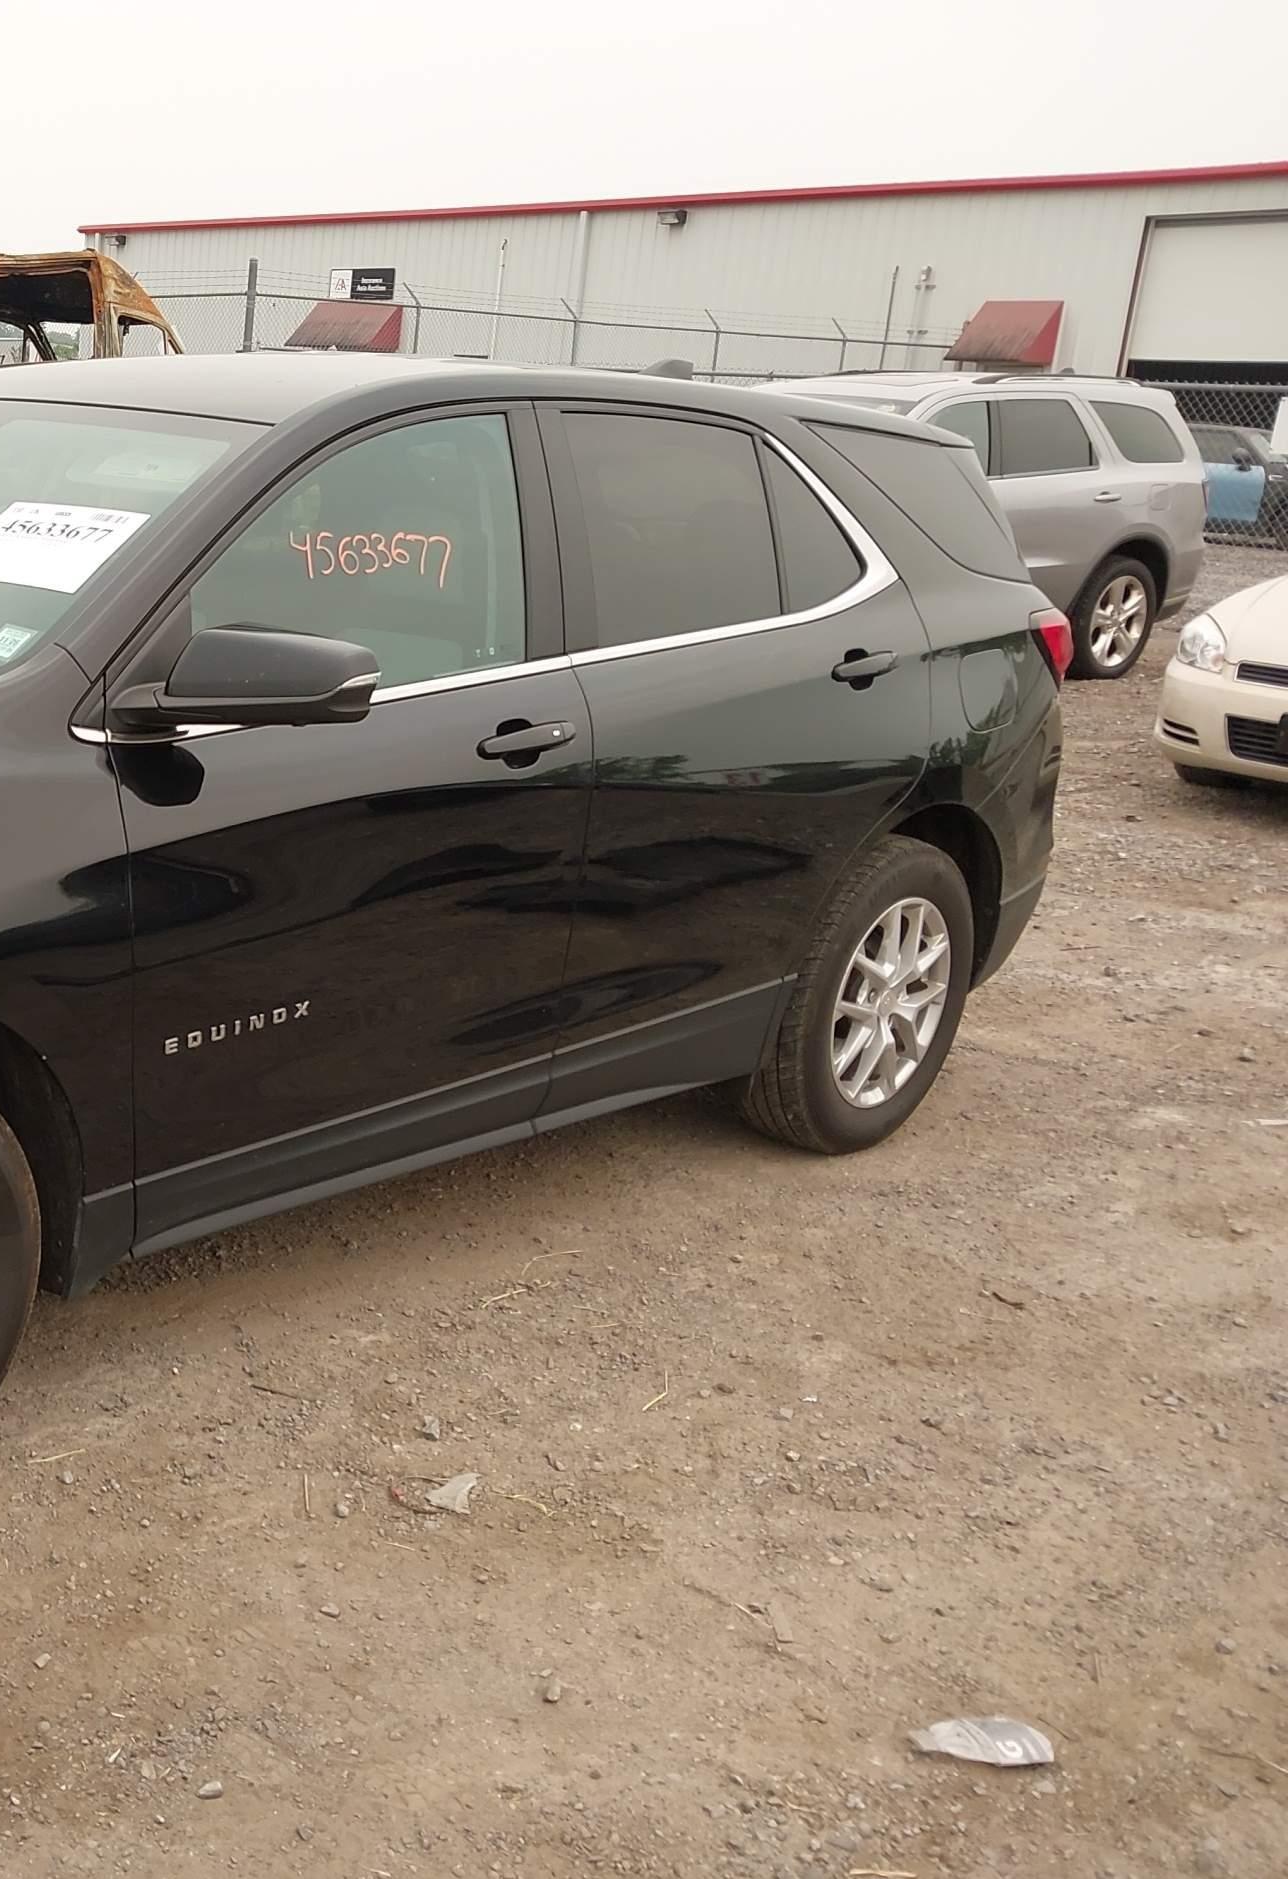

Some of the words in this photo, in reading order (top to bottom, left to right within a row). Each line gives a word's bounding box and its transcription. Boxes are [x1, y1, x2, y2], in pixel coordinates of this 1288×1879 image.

[1, 519, 114, 543] 45633677
[289, 530, 452, 589] 45633677
[164, 1000, 310, 1055] EQUINOX
